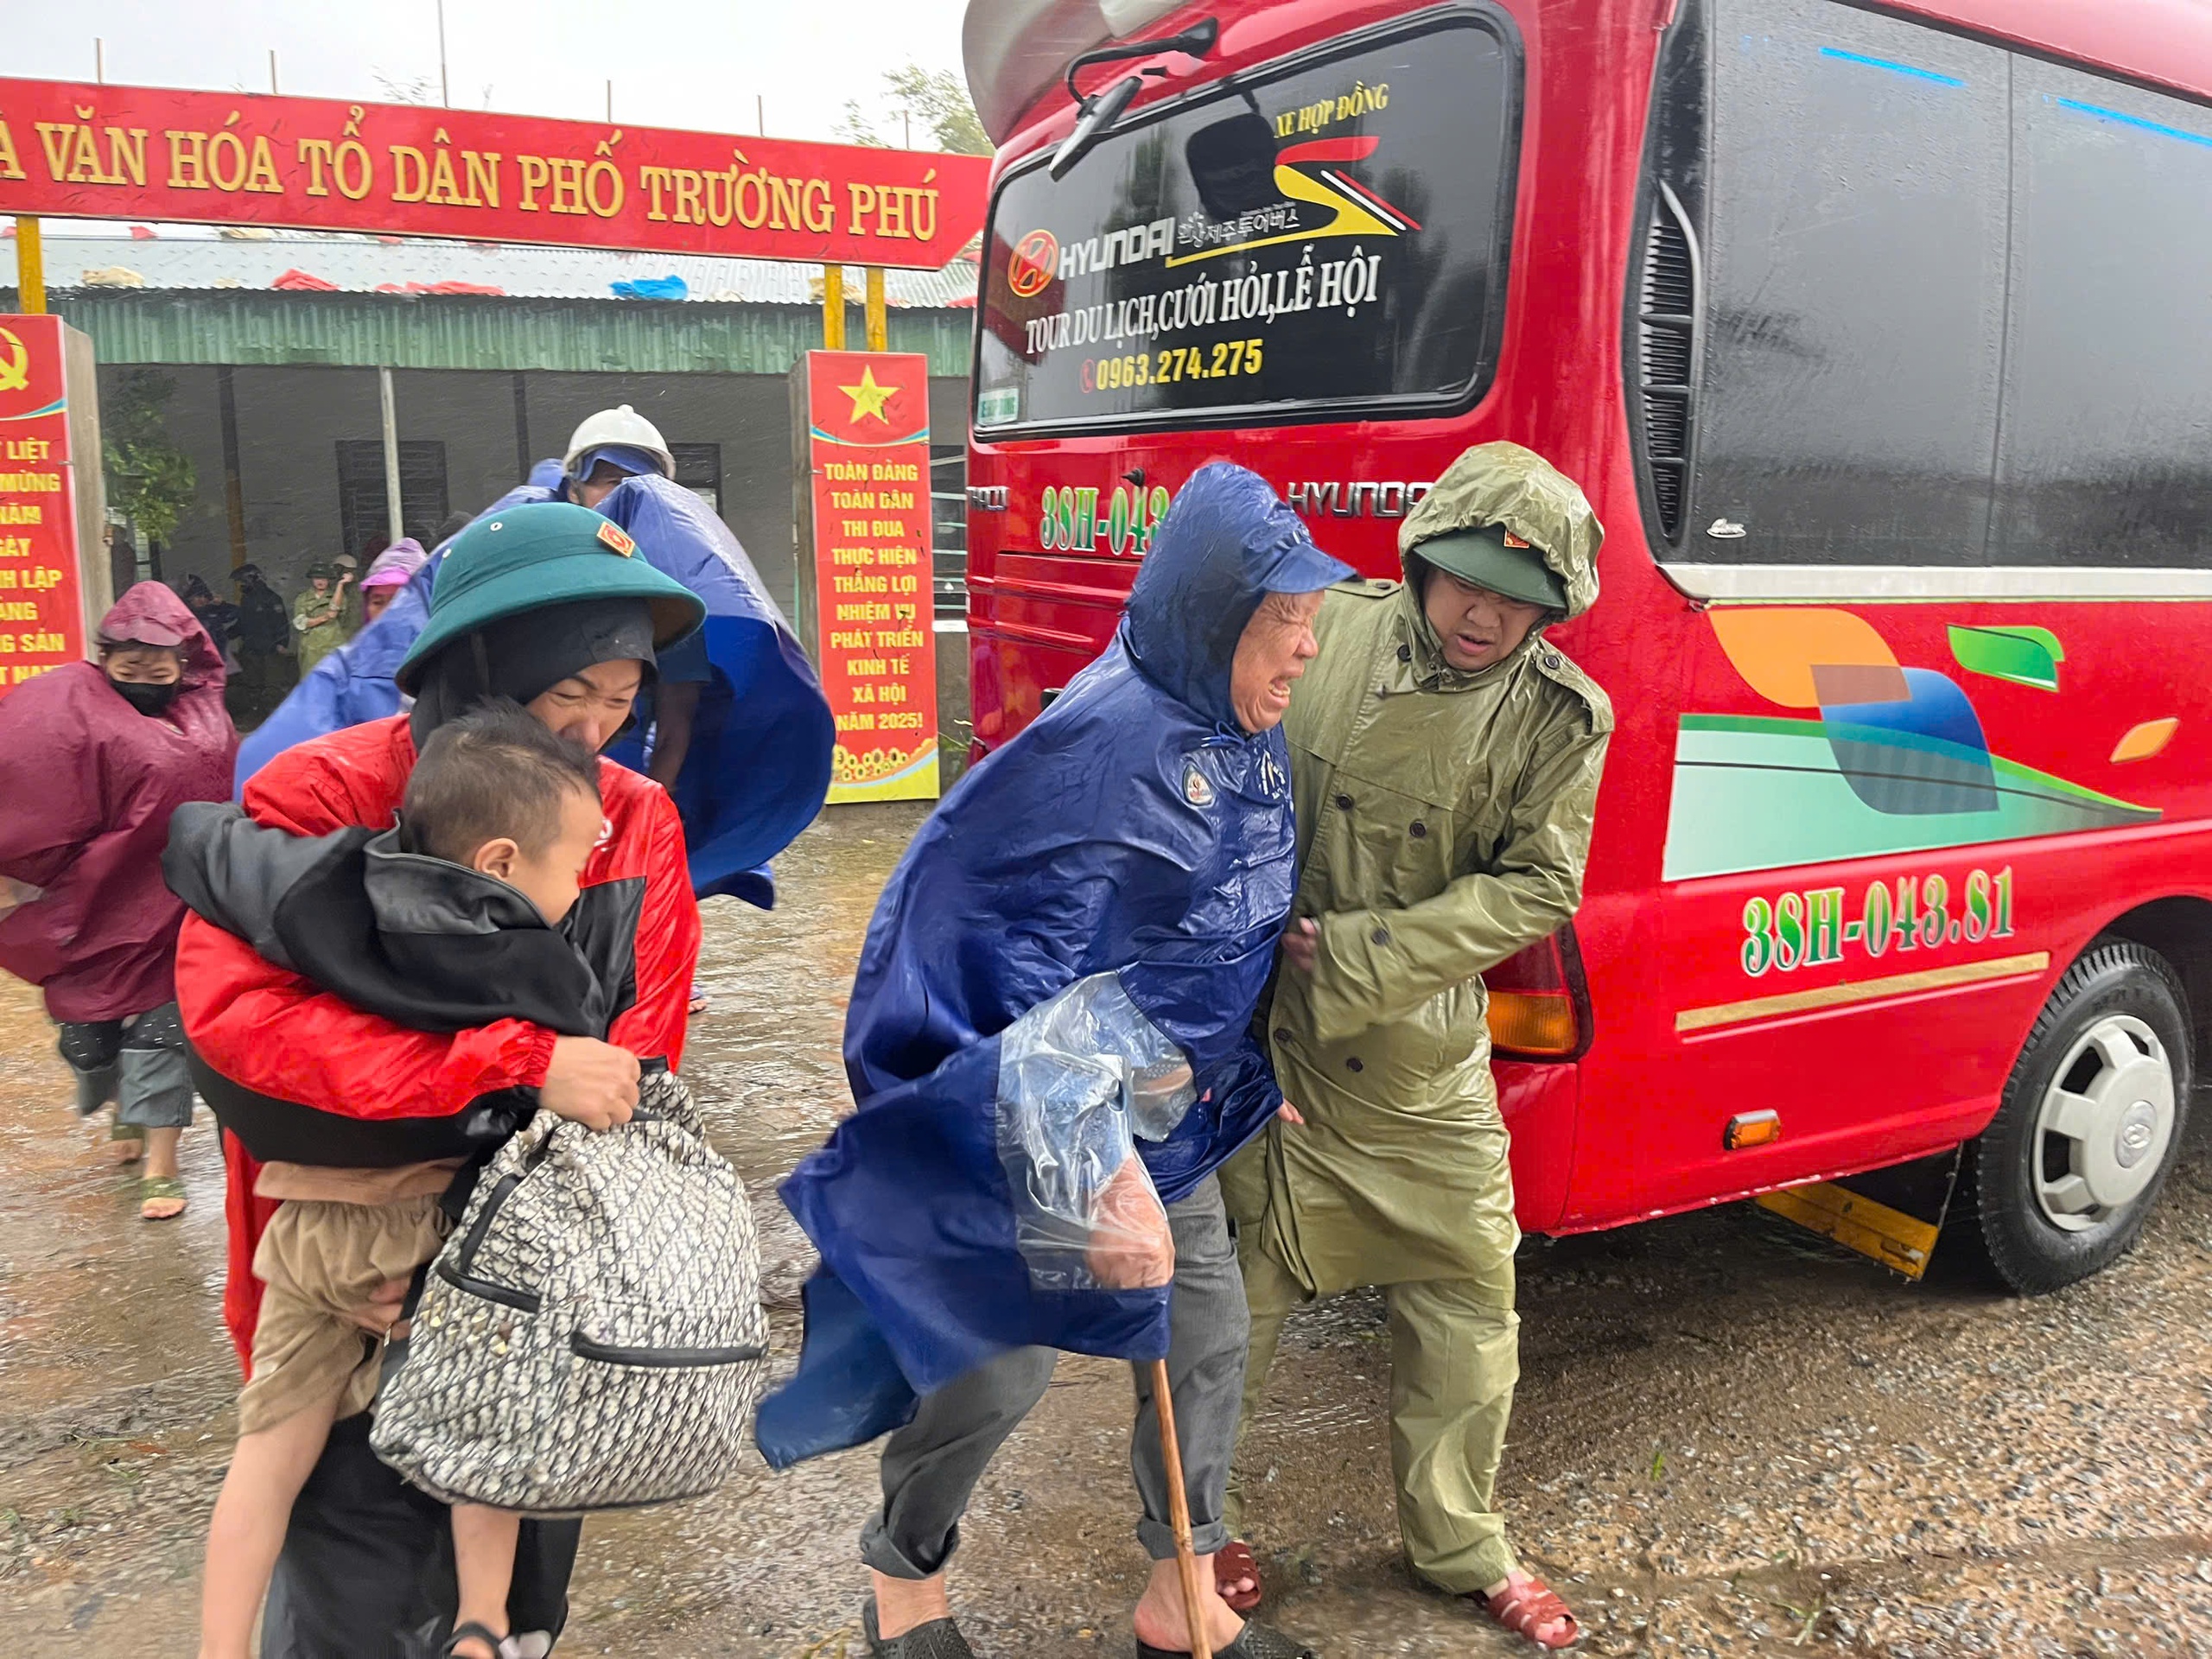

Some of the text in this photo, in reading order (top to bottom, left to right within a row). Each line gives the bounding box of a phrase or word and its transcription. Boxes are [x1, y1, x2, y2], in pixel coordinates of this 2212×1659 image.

[1274, 79, 1389, 138] XE HỢP ĐỒNG
[35, 105, 148, 186] VĂN
[166, 111, 283, 194] HÓA
[298, 105, 372, 200] TỔ
[389, 128, 501, 207] DÂN
[517, 130, 625, 217] PHỐ
[640, 149, 835, 232] TRƯỜNG
[848, 169, 938, 241] PHÚ
[1058, 217, 1175, 280] HYUNDAI
[1026, 312, 1071, 354] TOUR
[1072, 305, 1103, 346] DU
[1317, 245, 1382, 318] HỘI
[1096, 338, 1263, 390] 0963.274.275
[7, 436, 50, 464] LIỆT
[824, 459, 918, 481] TOÀN ĐẢNG
[831, 489, 914, 509] TOÀN DÂN
[1287, 481, 1434, 518] HYUNDA
[842, 520, 905, 537] THI ĐUA
[1040, 486, 1170, 556] 38H-043
[831, 545, 917, 569] THỰC HIỆN
[21, 566, 63, 593] LẬP
[834, 571, 917, 595] THẮNG LỢI
[836, 601, 916, 626] NHIỆM VỤ
[20, 627, 66, 652] SẢN
[830, 624, 924, 648] PHÁT TRIỂN
[847, 653, 910, 676] KINH TẾ
[853, 683, 906, 705] XÃ HỘI
[836, 712, 923, 731] NĂM 2025!
[1740, 865, 2015, 978] 38H-043.81
